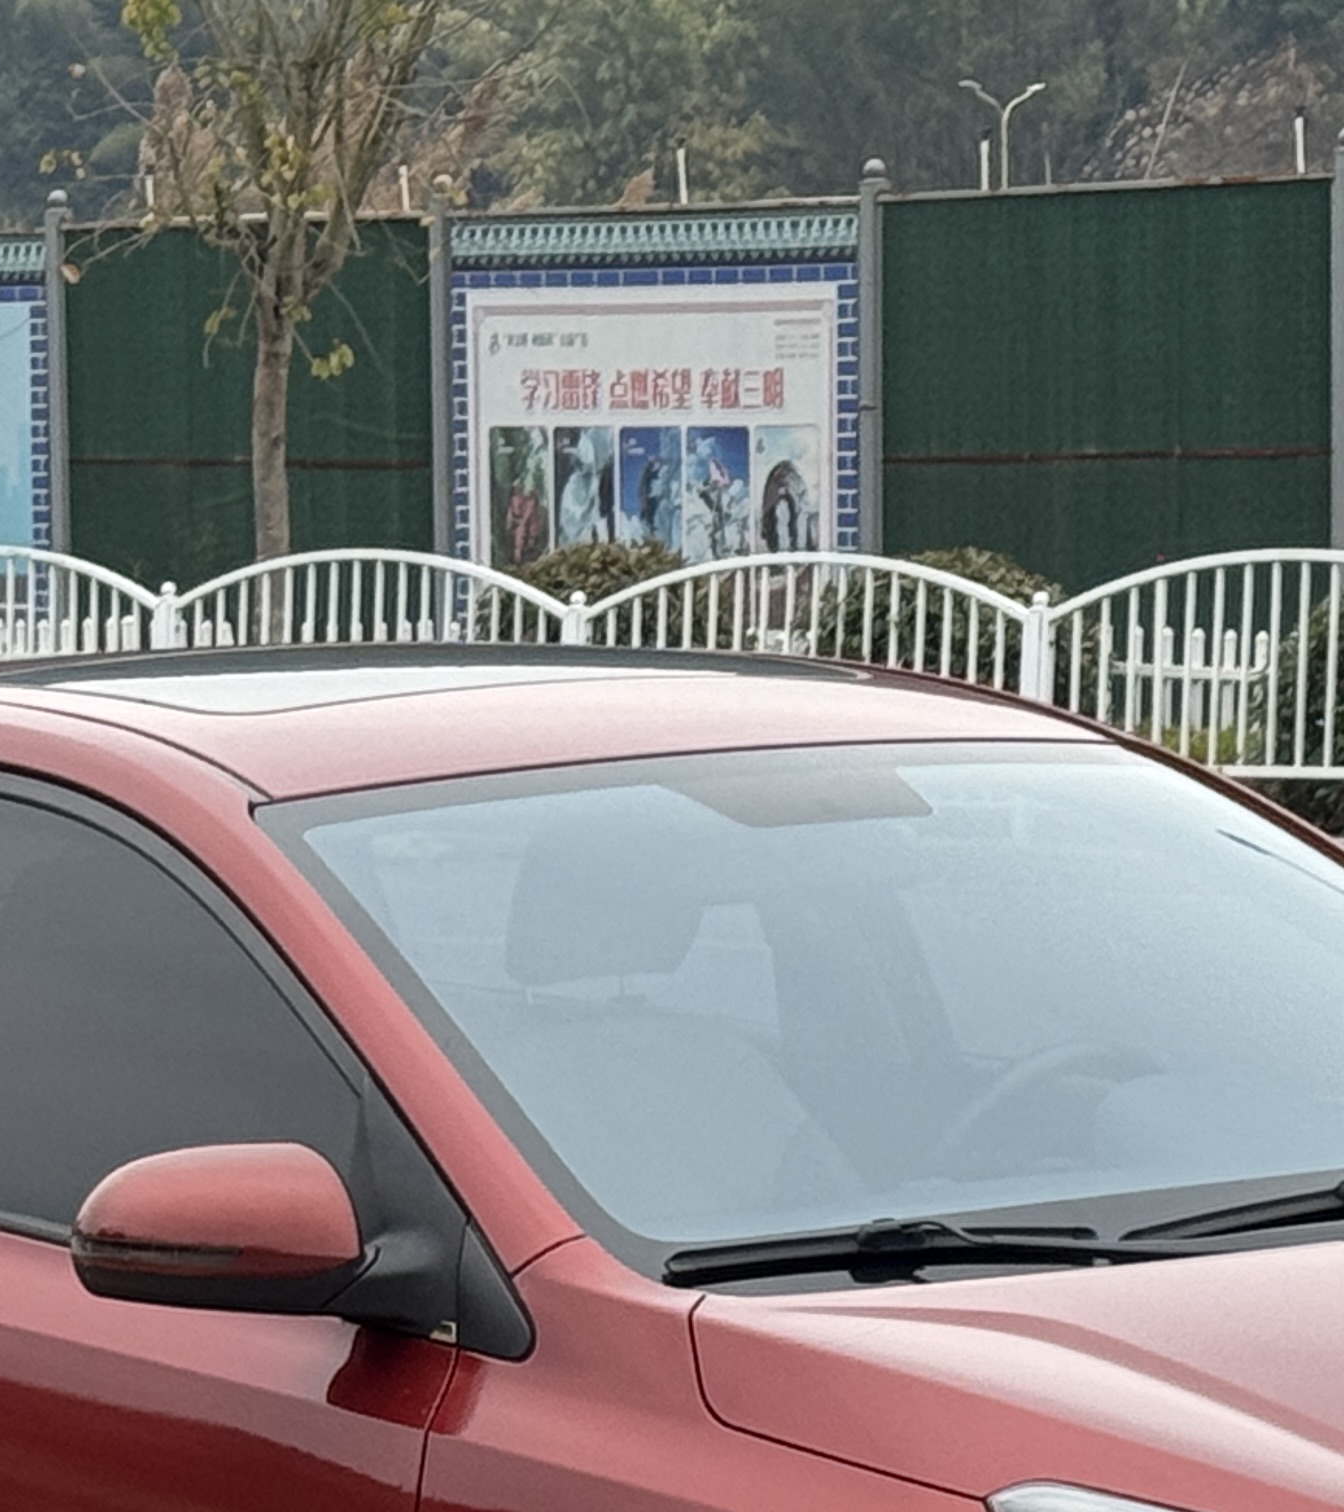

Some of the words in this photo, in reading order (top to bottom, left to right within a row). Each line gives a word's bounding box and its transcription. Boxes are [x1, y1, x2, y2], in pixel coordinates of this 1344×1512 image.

[520, 368, 602, 410] 学习雷锋
[609, 368, 693, 410] 点燃希望
[700, 367, 785, 410] 奉献三明
